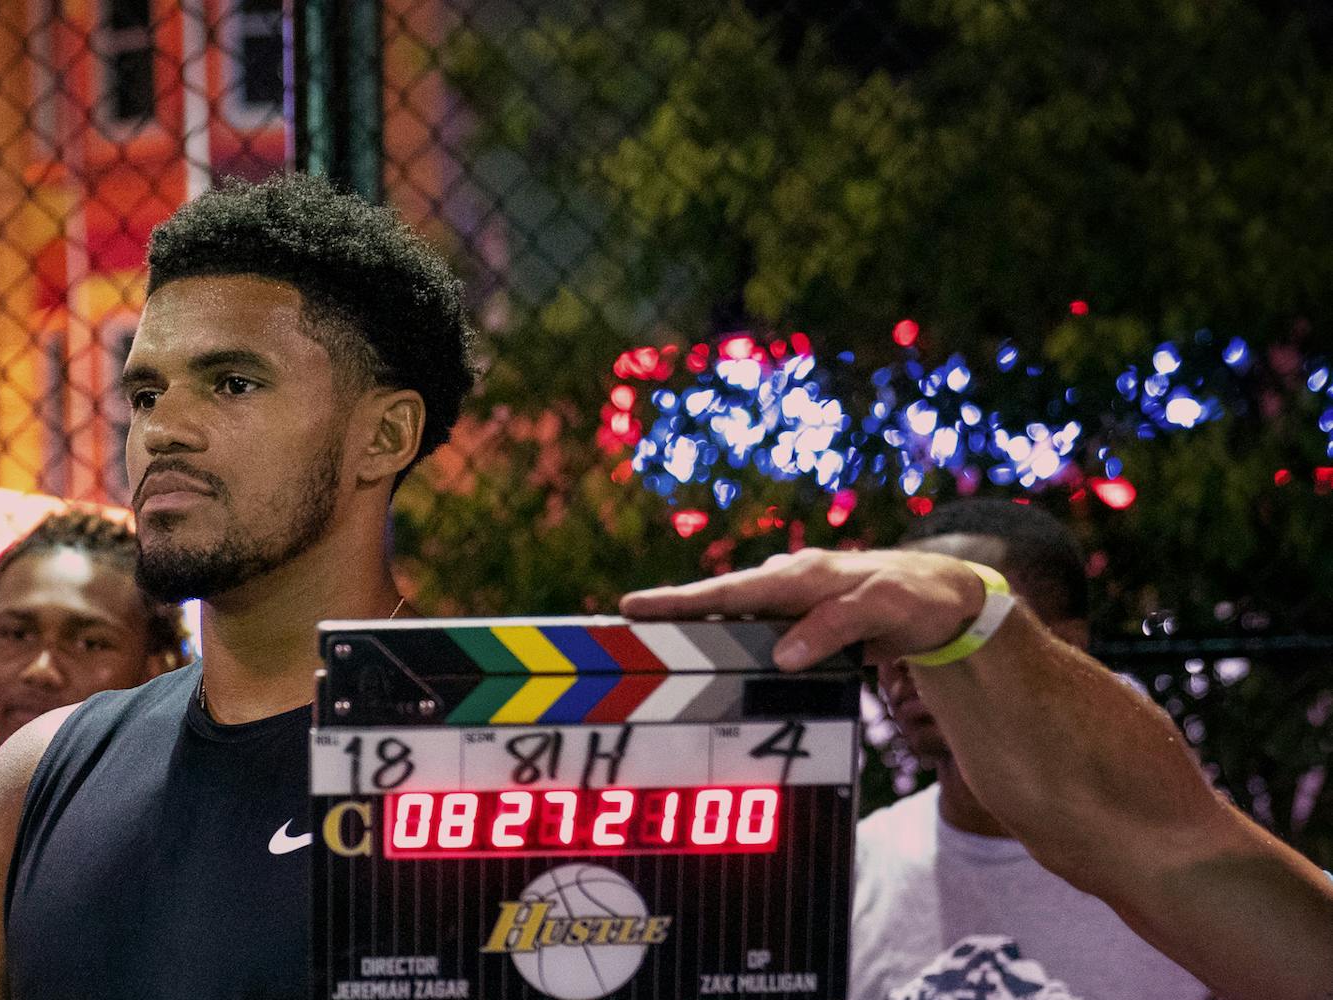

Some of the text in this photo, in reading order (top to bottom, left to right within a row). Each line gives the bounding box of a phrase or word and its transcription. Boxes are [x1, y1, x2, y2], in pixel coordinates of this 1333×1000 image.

[747, 720, 810, 785] 4
[344, 734, 415, 794] 18
[360, 956, 439, 977] DIRECTOR
[747, 950, 771, 969] DP
[331, 979, 469, 1000] JEREMIAH ZAGAR
[700, 972, 817, 994] ZAK MULLIGAN
